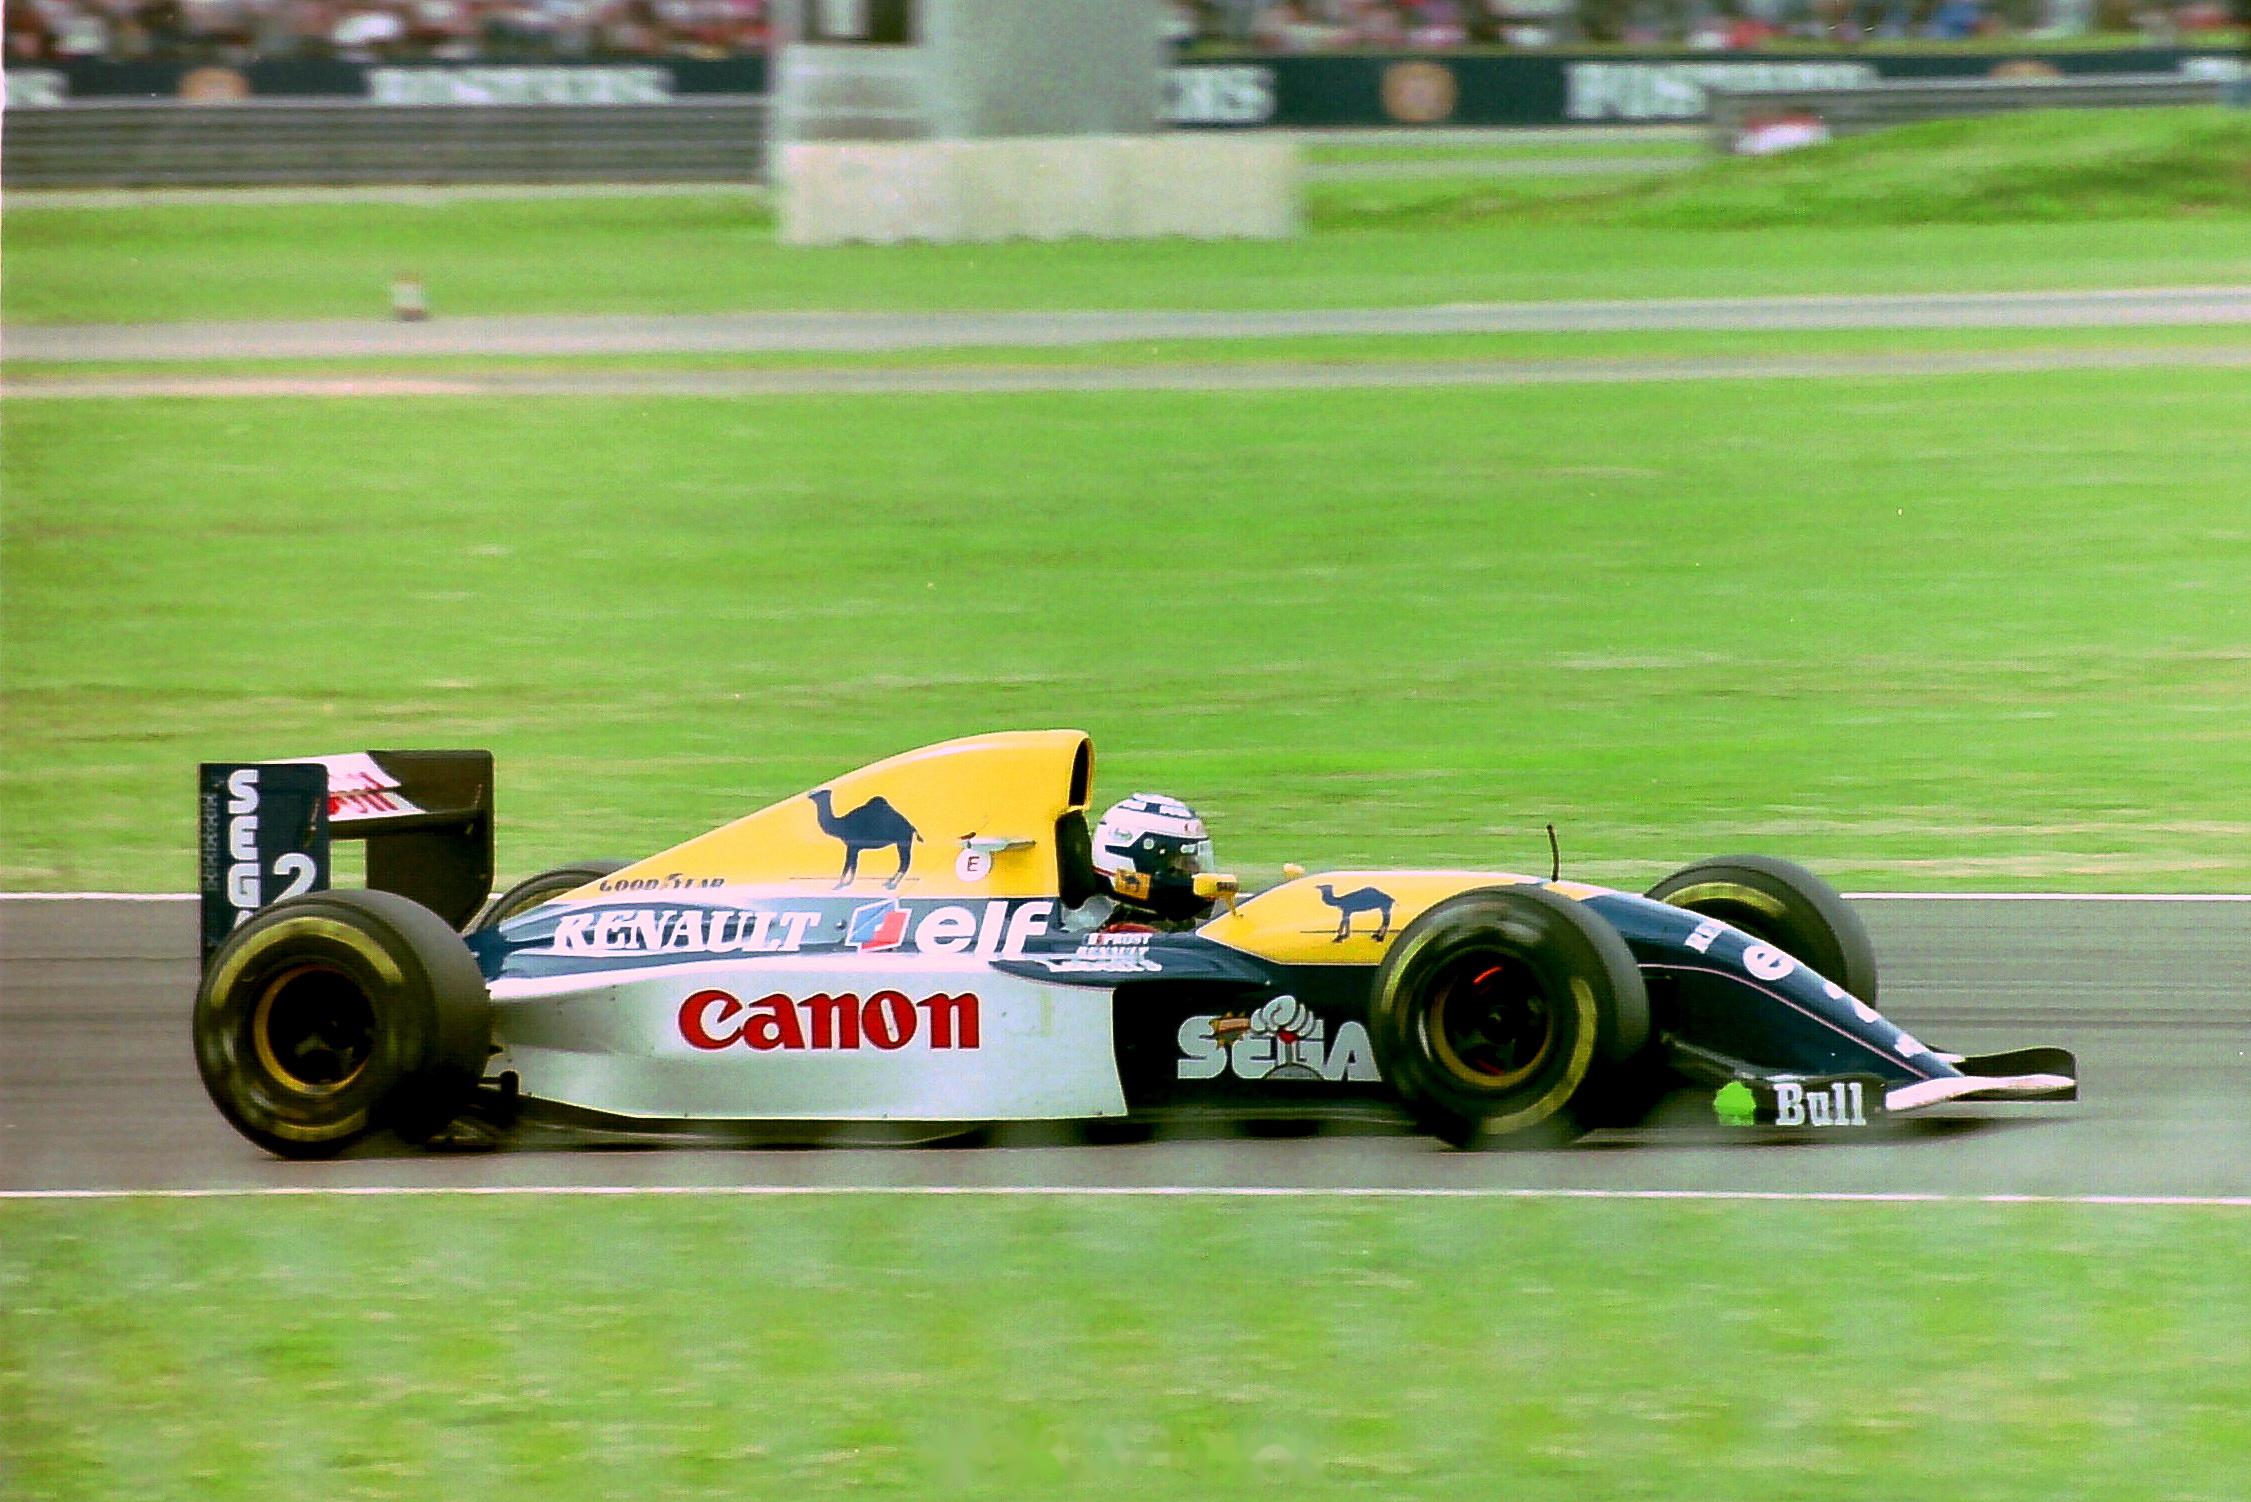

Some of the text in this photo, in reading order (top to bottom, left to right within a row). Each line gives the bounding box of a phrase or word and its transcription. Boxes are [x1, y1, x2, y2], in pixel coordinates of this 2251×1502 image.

[228, 768, 261, 929] SEG
[967, 855, 980, 872] E
[273, 853, 317, 903] 2
[552, 909, 822, 953] RENAULT
[915, 900, 1054, 953] elf
[679, 989, 980, 1051] Canon
[1773, 1082, 1867, 1127] Bull
